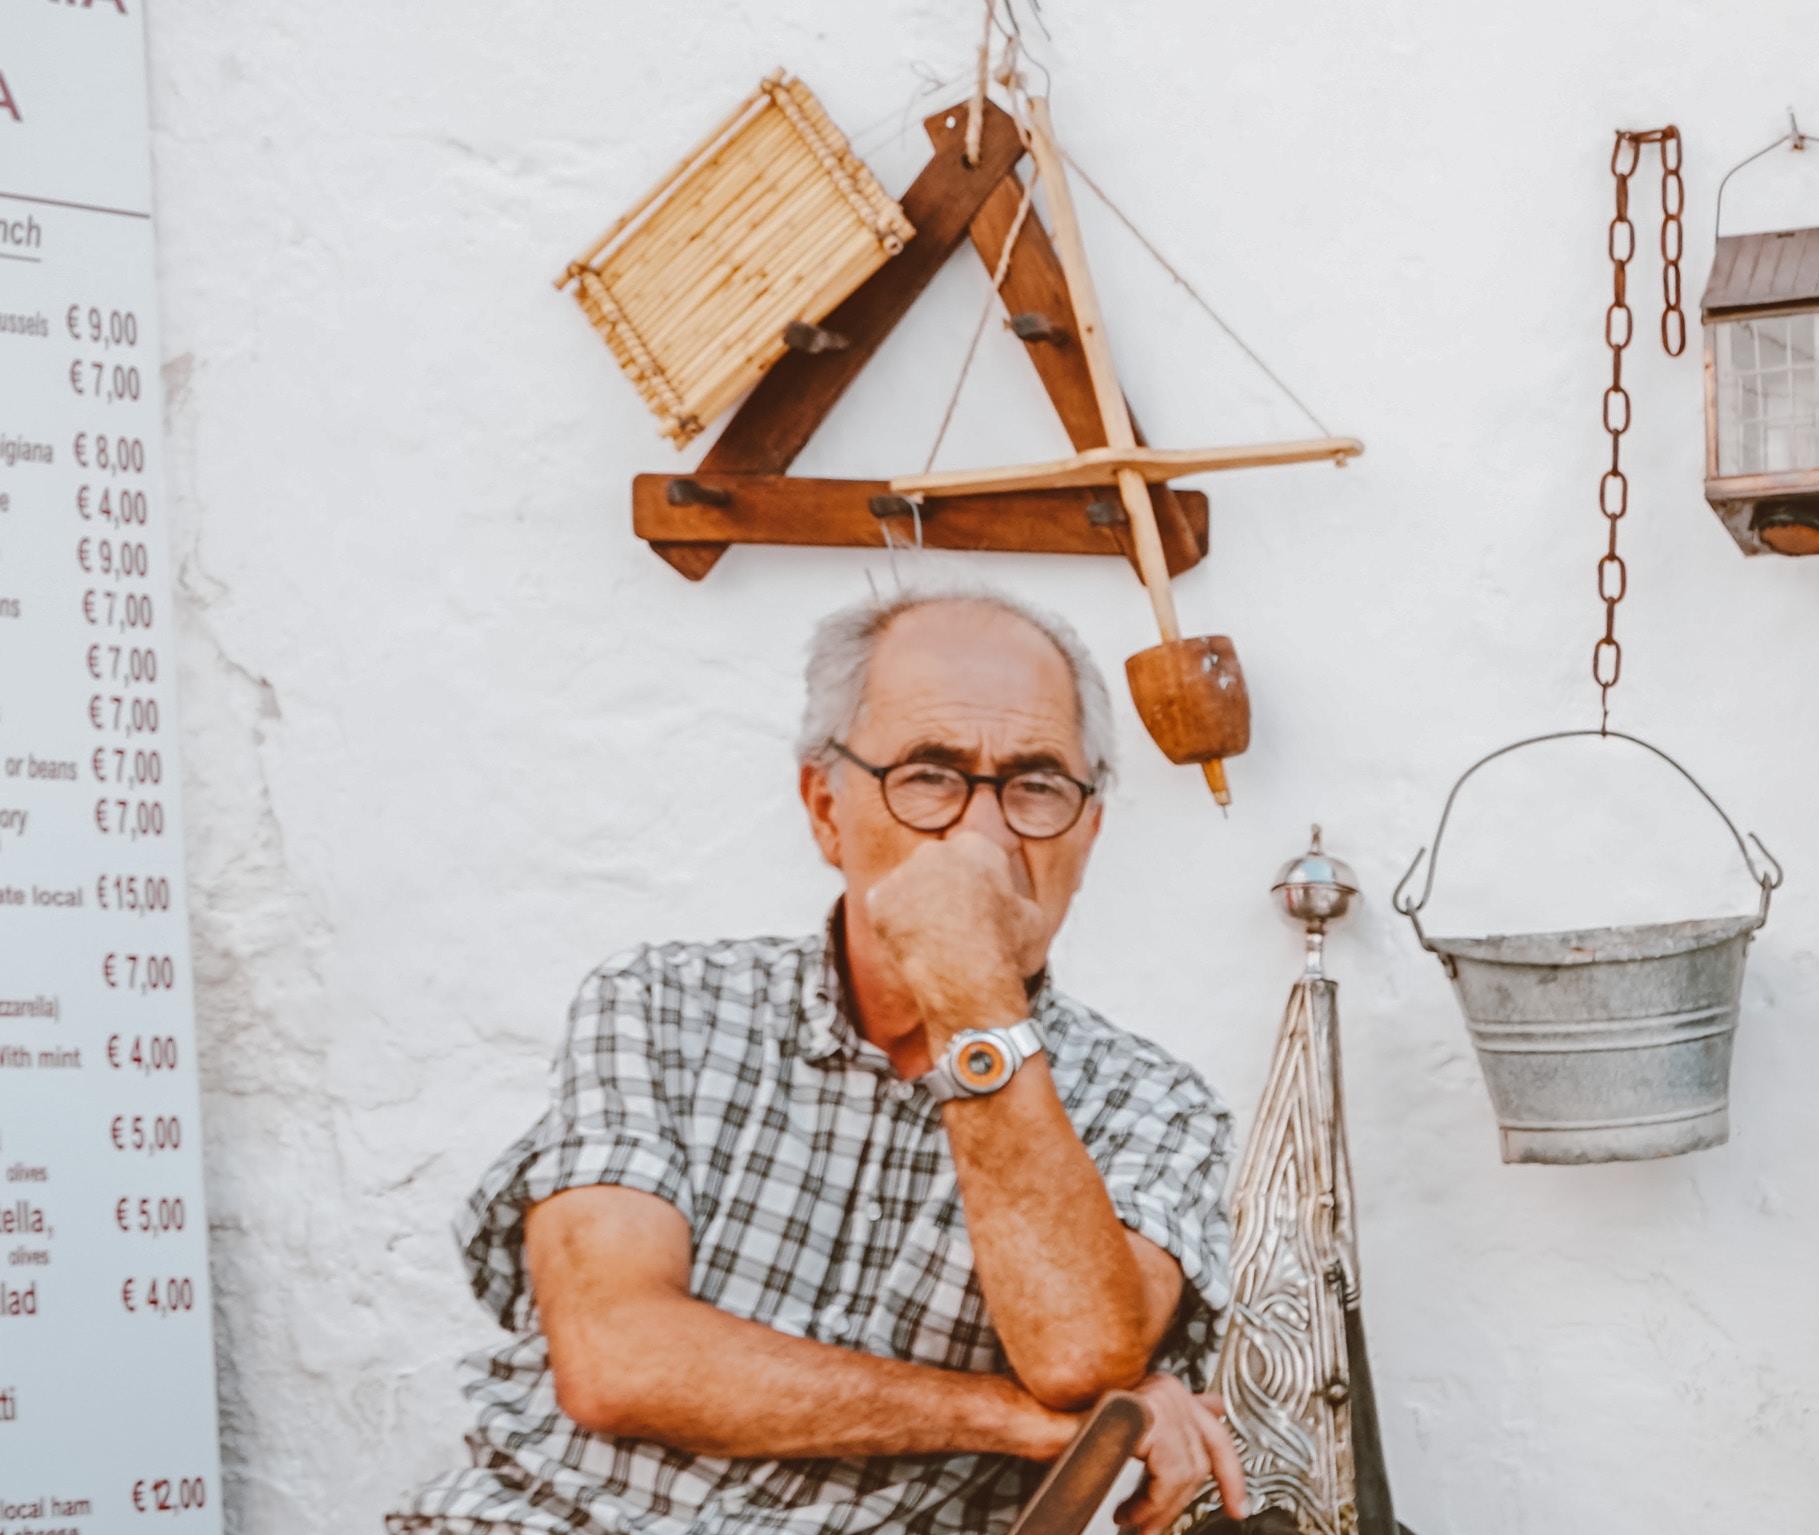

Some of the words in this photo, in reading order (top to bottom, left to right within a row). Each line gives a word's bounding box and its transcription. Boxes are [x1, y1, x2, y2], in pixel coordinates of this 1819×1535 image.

[88, 306, 138, 350] 9,00
[91, 361, 140, 404] 7,00
[96, 434, 144, 477] 8,00
[99, 487, 147, 529] 4,00
[99, 540, 147, 582] 9,00
[103, 591, 152, 634] 7,00
[107, 647, 156, 688] 7,00
[110, 697, 158, 738] 7,00
[28, 752, 77, 781] beans
[114, 749, 161, 790] 7,00
[116, 801, 164, 842] 7,00
[32, 885, 83, 908] local
[115, 875, 169, 918] 15,00
[126, 954, 174, 995] 7,00
[38, 1046, 82, 1069] mint
[130, 1036, 177, 1076] 4,00
[132, 1116, 182, 1157] 5,00
[0, 1200, 54, 1239] ella,
[138, 1198, 186, 1238] 5,00
[146, 1278, 193, 1318] 4,00
[50, 1497, 92, 1517] ham
[152, 1477, 206, 1516] 12,00
